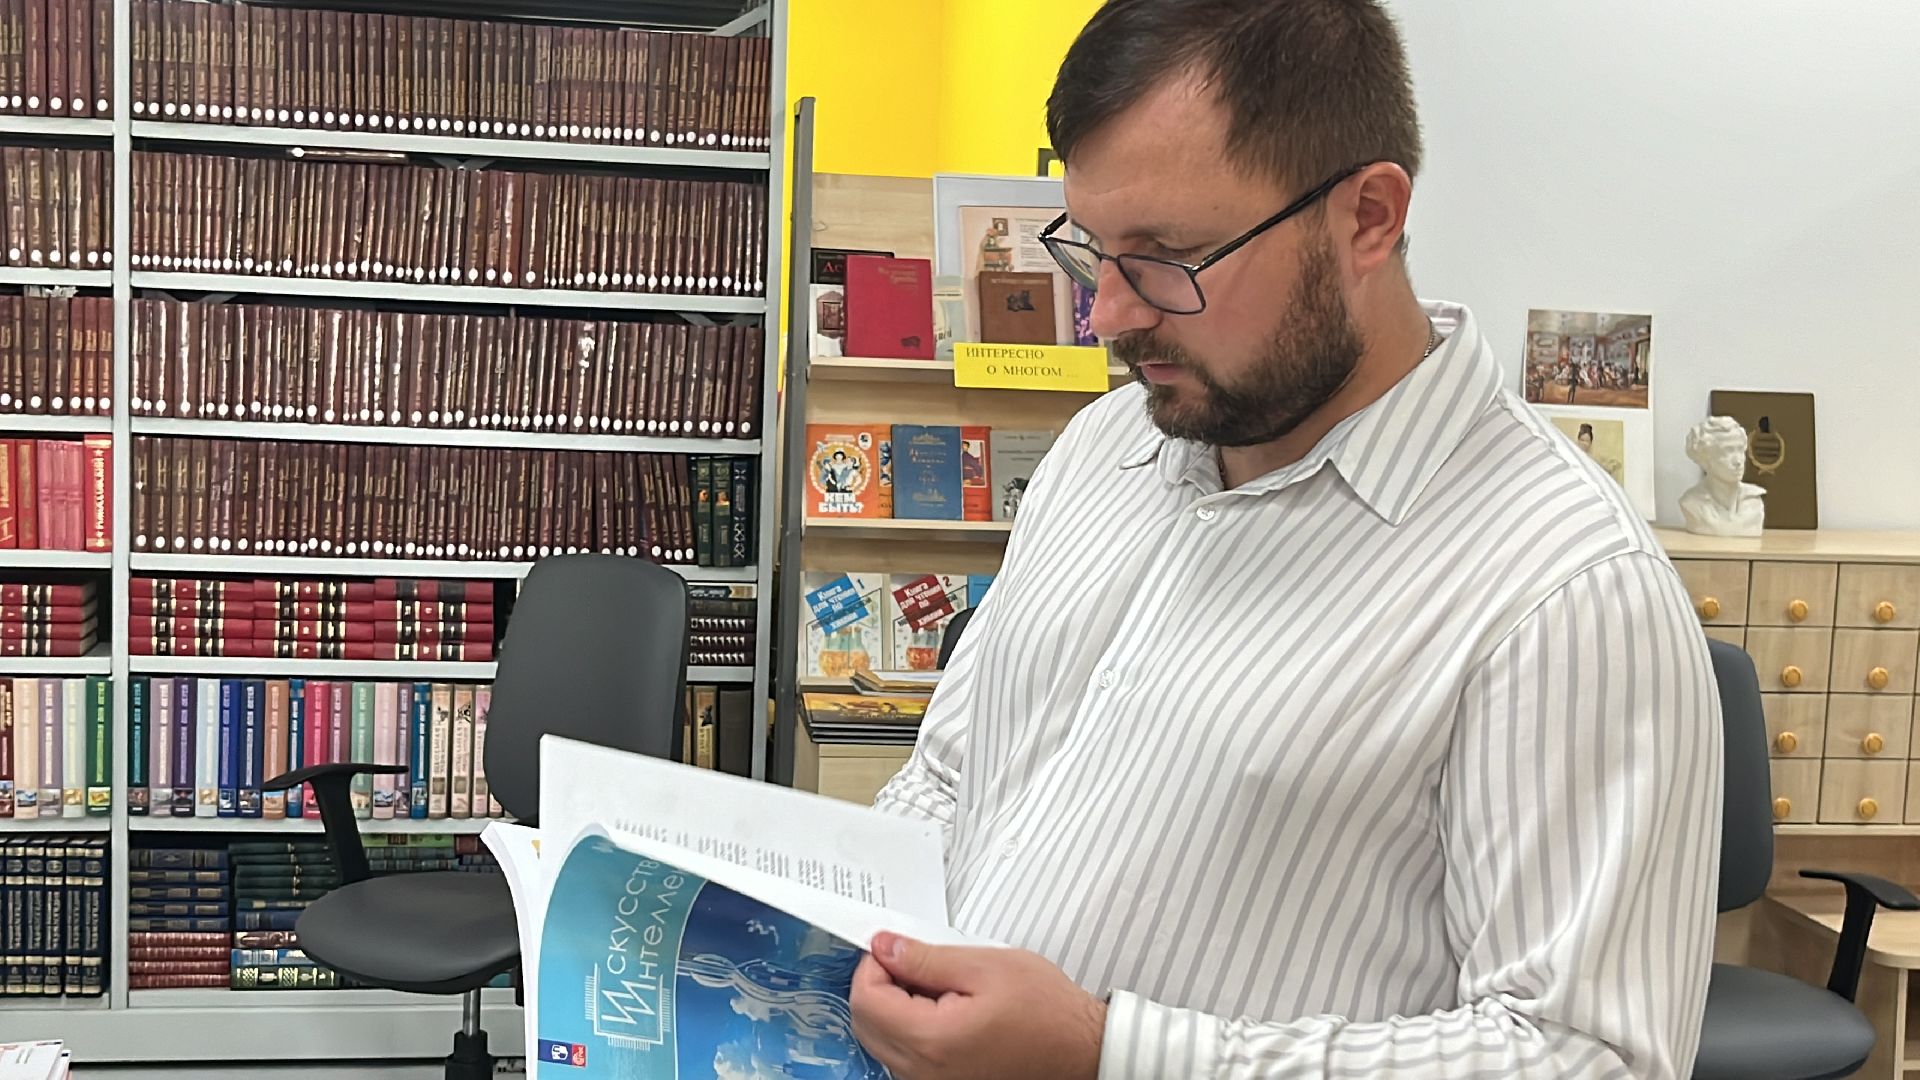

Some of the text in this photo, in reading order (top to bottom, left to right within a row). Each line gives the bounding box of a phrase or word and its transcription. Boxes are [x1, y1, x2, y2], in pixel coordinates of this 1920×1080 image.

[966, 346, 1045, 360] ИНТЕРЕСНО
[986, 364, 1062, 377] О МНОГОМ
[824, 492, 856, 503] КЕМ
[818, 502, 865, 513] БЫТЬ?
[942, 576, 952, 587] 2
[601, 858, 661, 1025] ИСКУССТВ
[621, 870, 686, 1015] ИНТЕЛЛЕ
